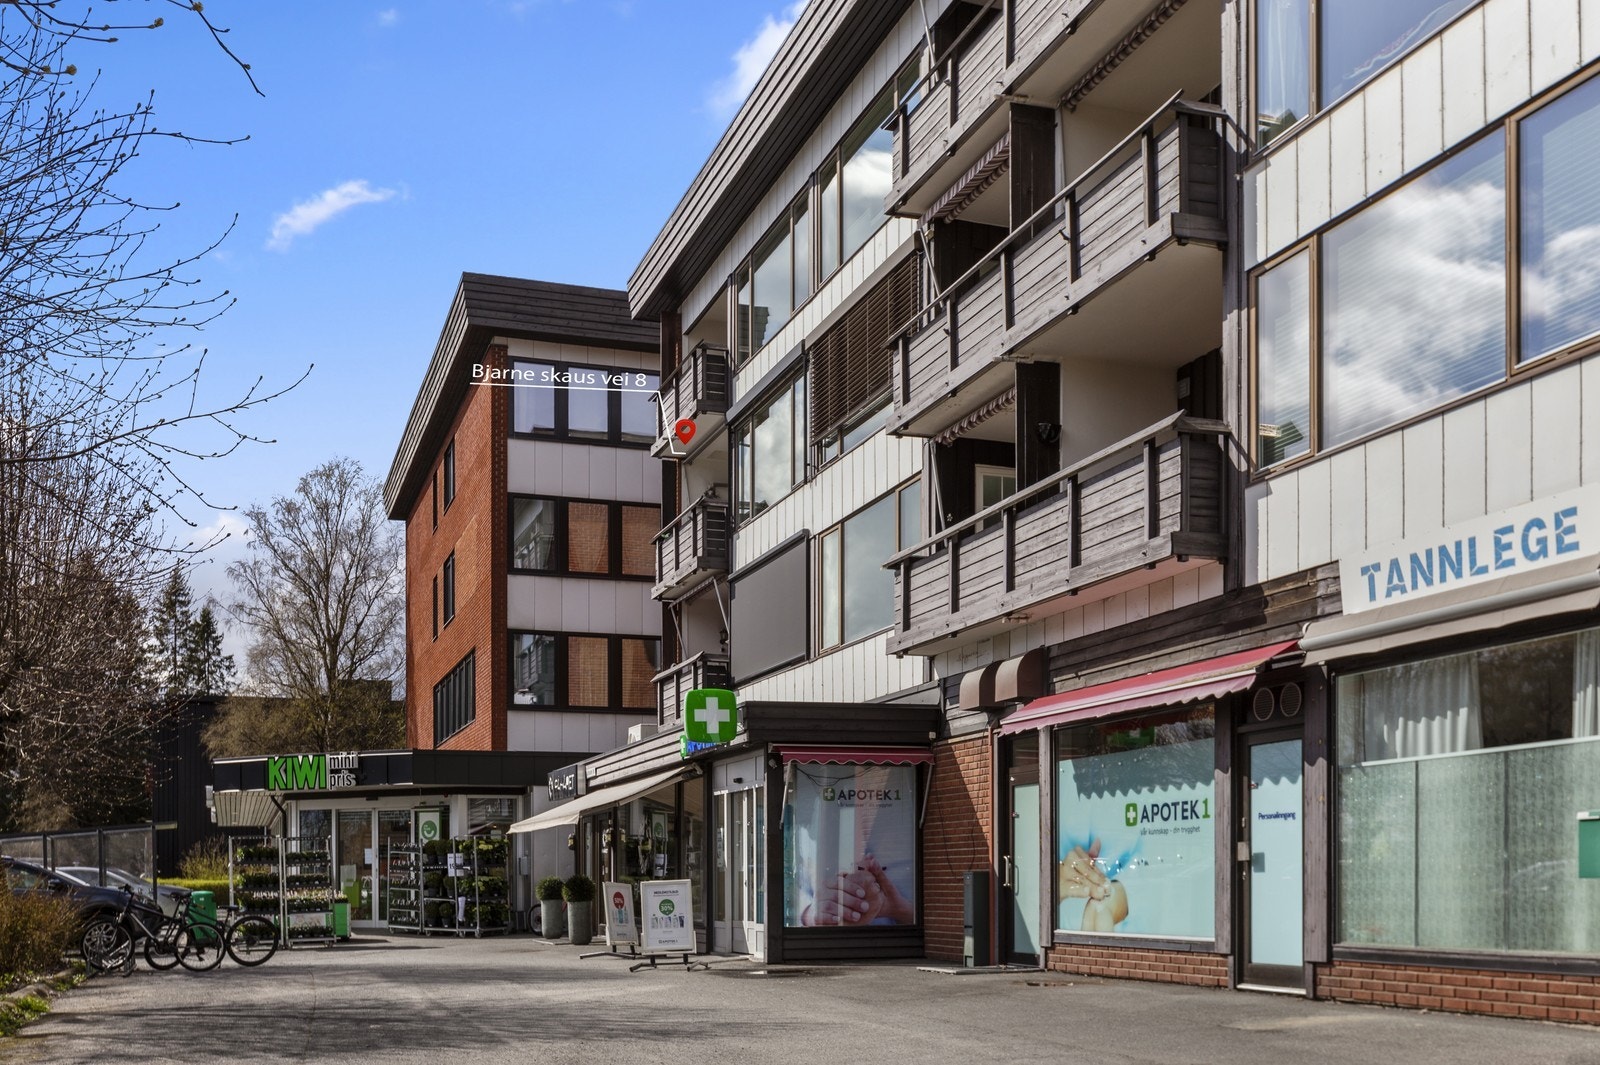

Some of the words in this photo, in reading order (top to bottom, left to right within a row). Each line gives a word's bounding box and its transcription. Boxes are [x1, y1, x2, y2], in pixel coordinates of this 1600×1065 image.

[1360, 506, 1580, 602] TANNLEGE
[329, 752, 358, 769] mini
[267, 754, 327, 791] KIWI
[329, 770, 355, 790] pris
[837, 789, 892, 801] APOTEK
[894, 789, 902, 801] 1
[1140, 799, 1200, 824] APOTEK
[1202, 797, 1211, 819] 1
